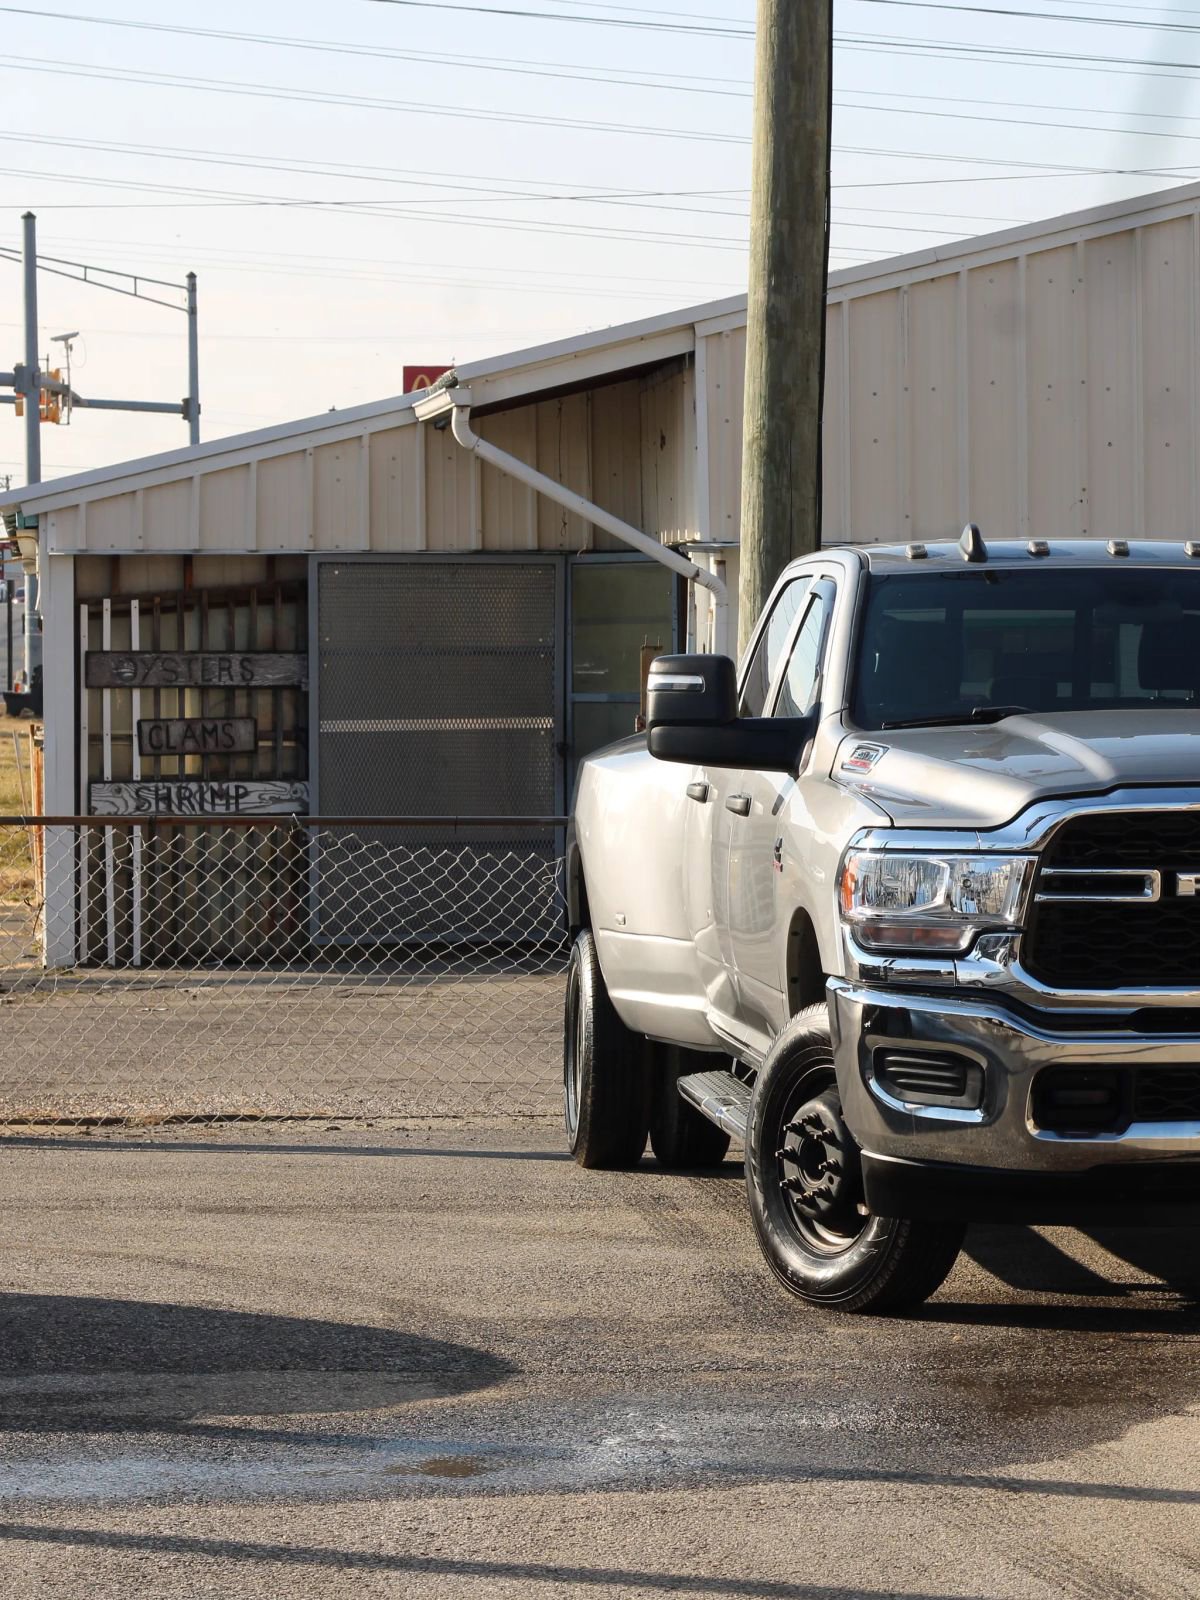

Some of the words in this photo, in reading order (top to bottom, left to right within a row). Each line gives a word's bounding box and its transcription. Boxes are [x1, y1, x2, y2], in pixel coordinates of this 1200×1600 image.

[111, 656, 255, 684] OYSTERS
[149, 723, 236, 749] CLAMS
[136, 784, 248, 812] SHRIMP
